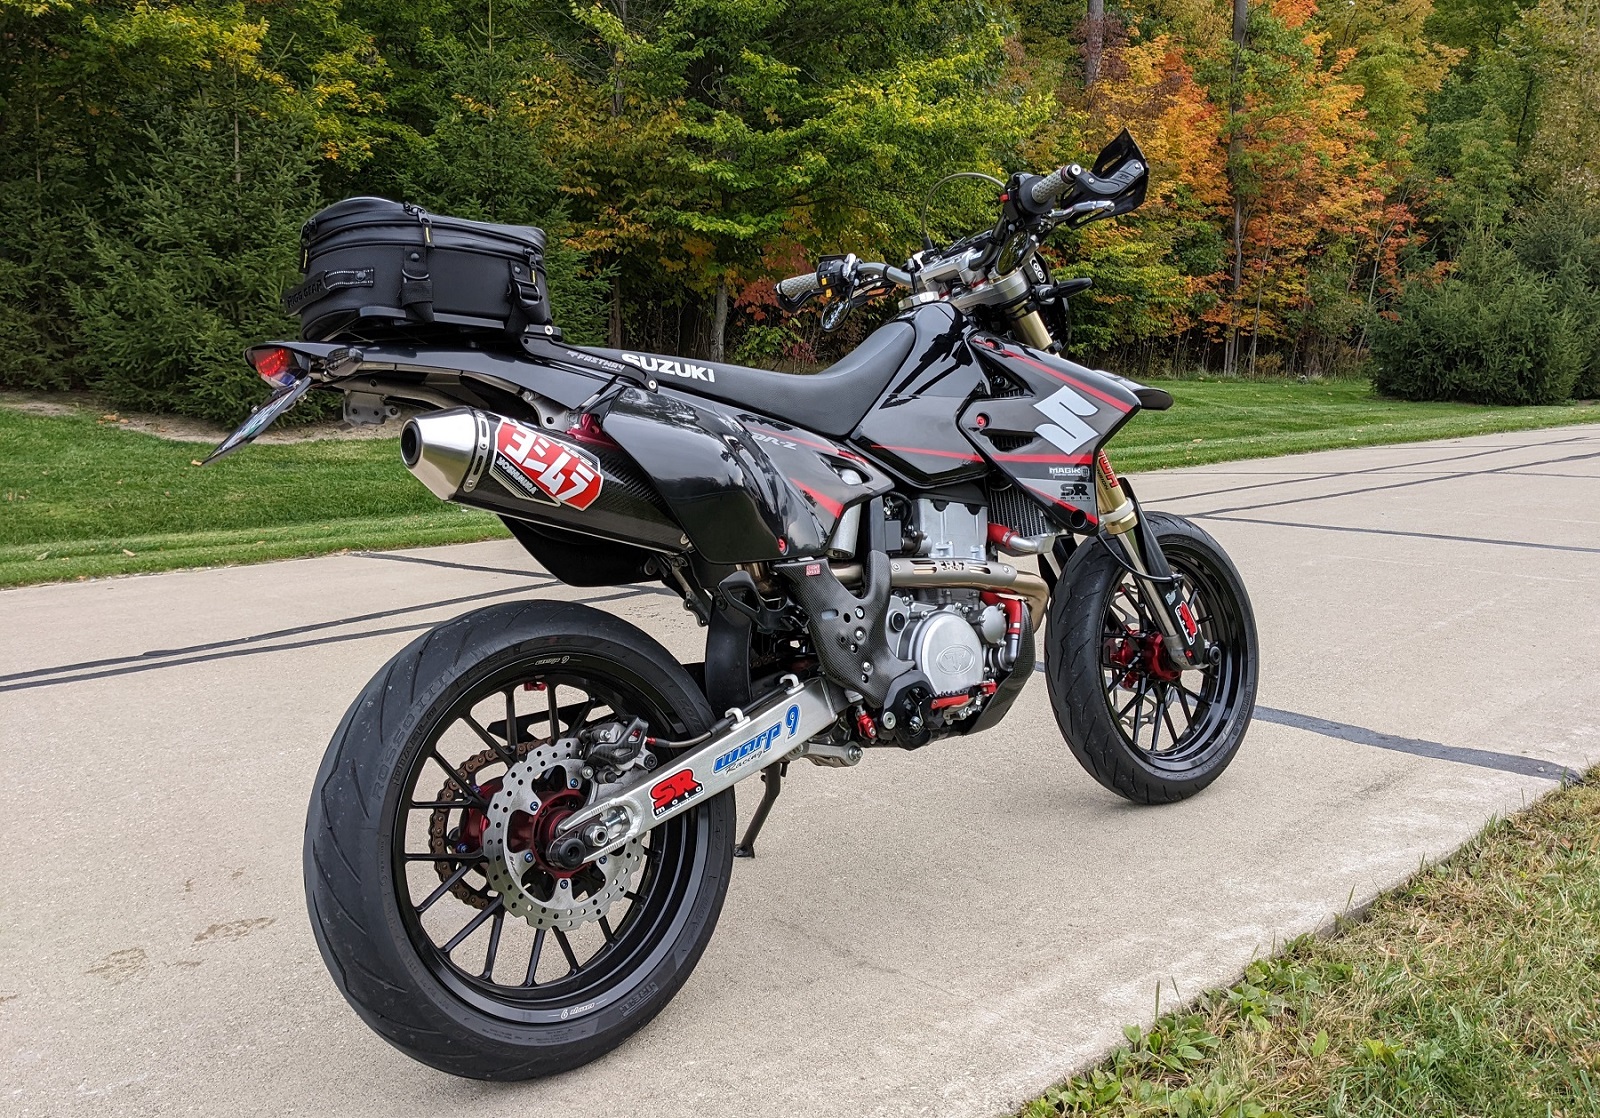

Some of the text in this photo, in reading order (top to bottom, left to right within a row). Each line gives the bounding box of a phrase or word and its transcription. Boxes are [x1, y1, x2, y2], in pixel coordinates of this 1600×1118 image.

[576, 352, 626, 371] FASTWAY
[621, 353, 715, 383] SUZUKI
[496, 456, 538, 495] YOSHIMURA
[504, 427, 596, 501] ヨシムラ
[1049, 466, 1080, 476] MAGIK
[1061, 483, 1088, 497] SR
[713, 704, 800, 773] warp 9
[725, 750, 764, 776] Racing
[650, 769, 699, 809] SR
[655, 785, 702, 815] moto
